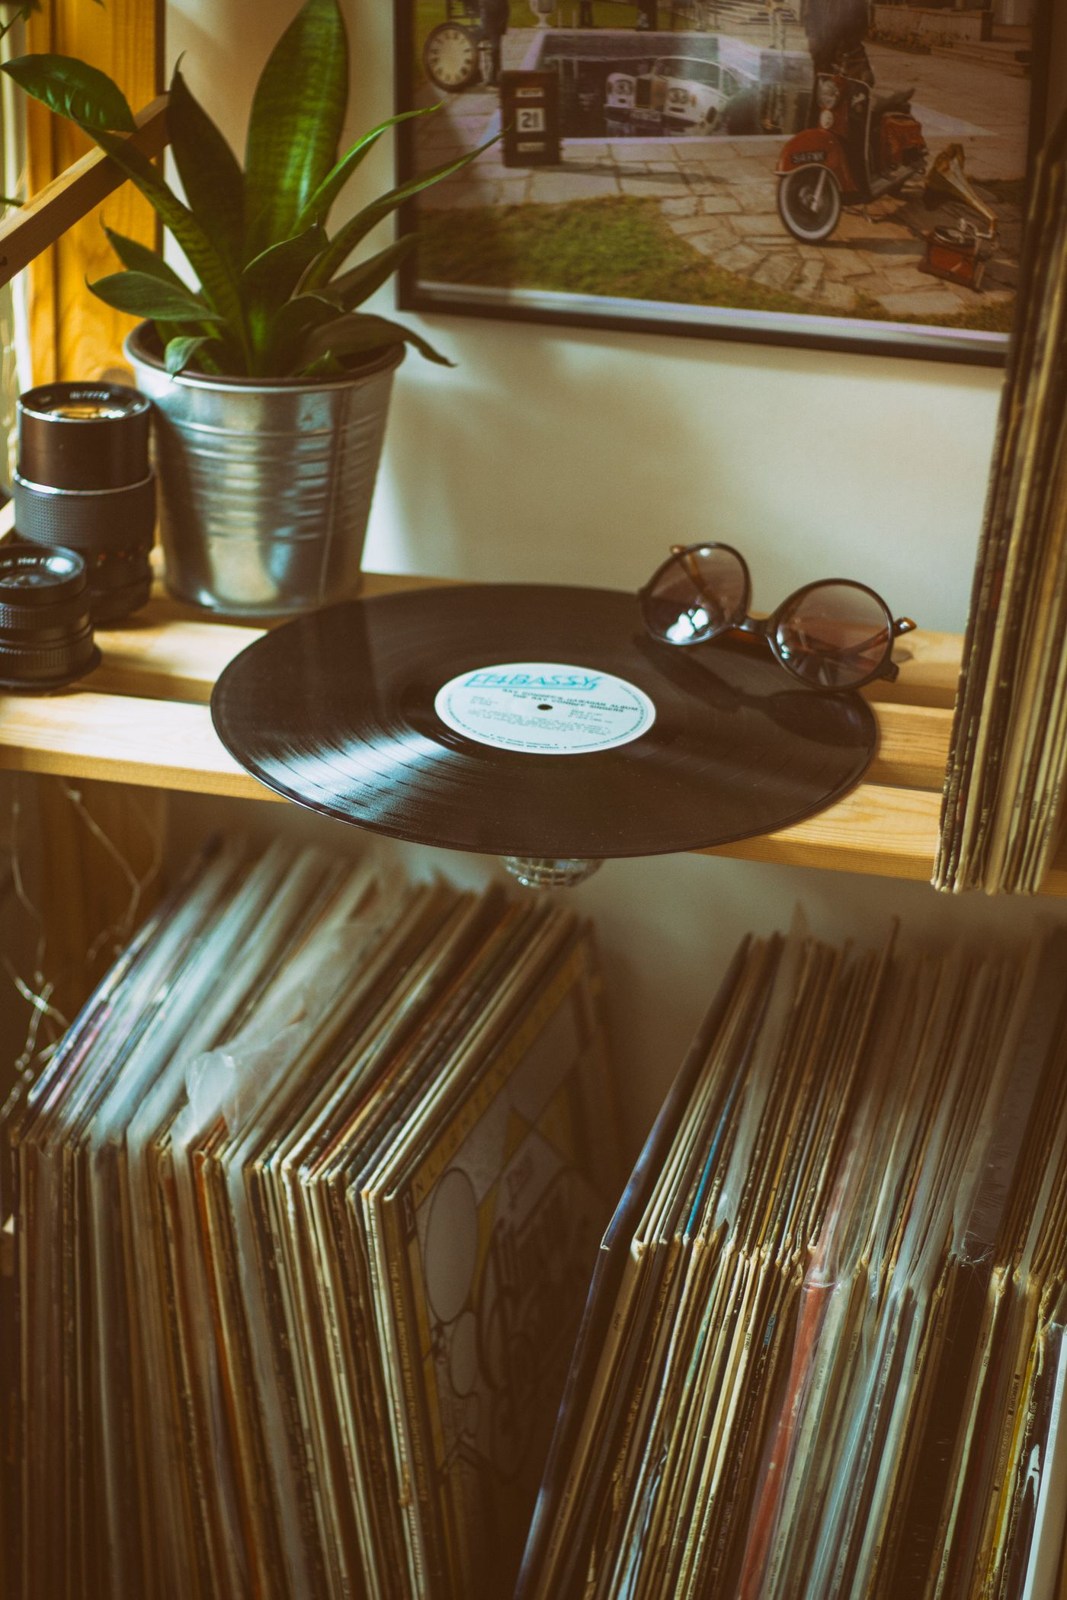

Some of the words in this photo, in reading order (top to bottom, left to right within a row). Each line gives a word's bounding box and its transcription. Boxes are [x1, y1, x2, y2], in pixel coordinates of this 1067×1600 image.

[464, 672, 604, 691] EMBASSY
[387, 1260, 399, 1280] THE
[389, 1280, 405, 1319] ALLMAN
[394, 1320, 412, 1369] BROTHERS
